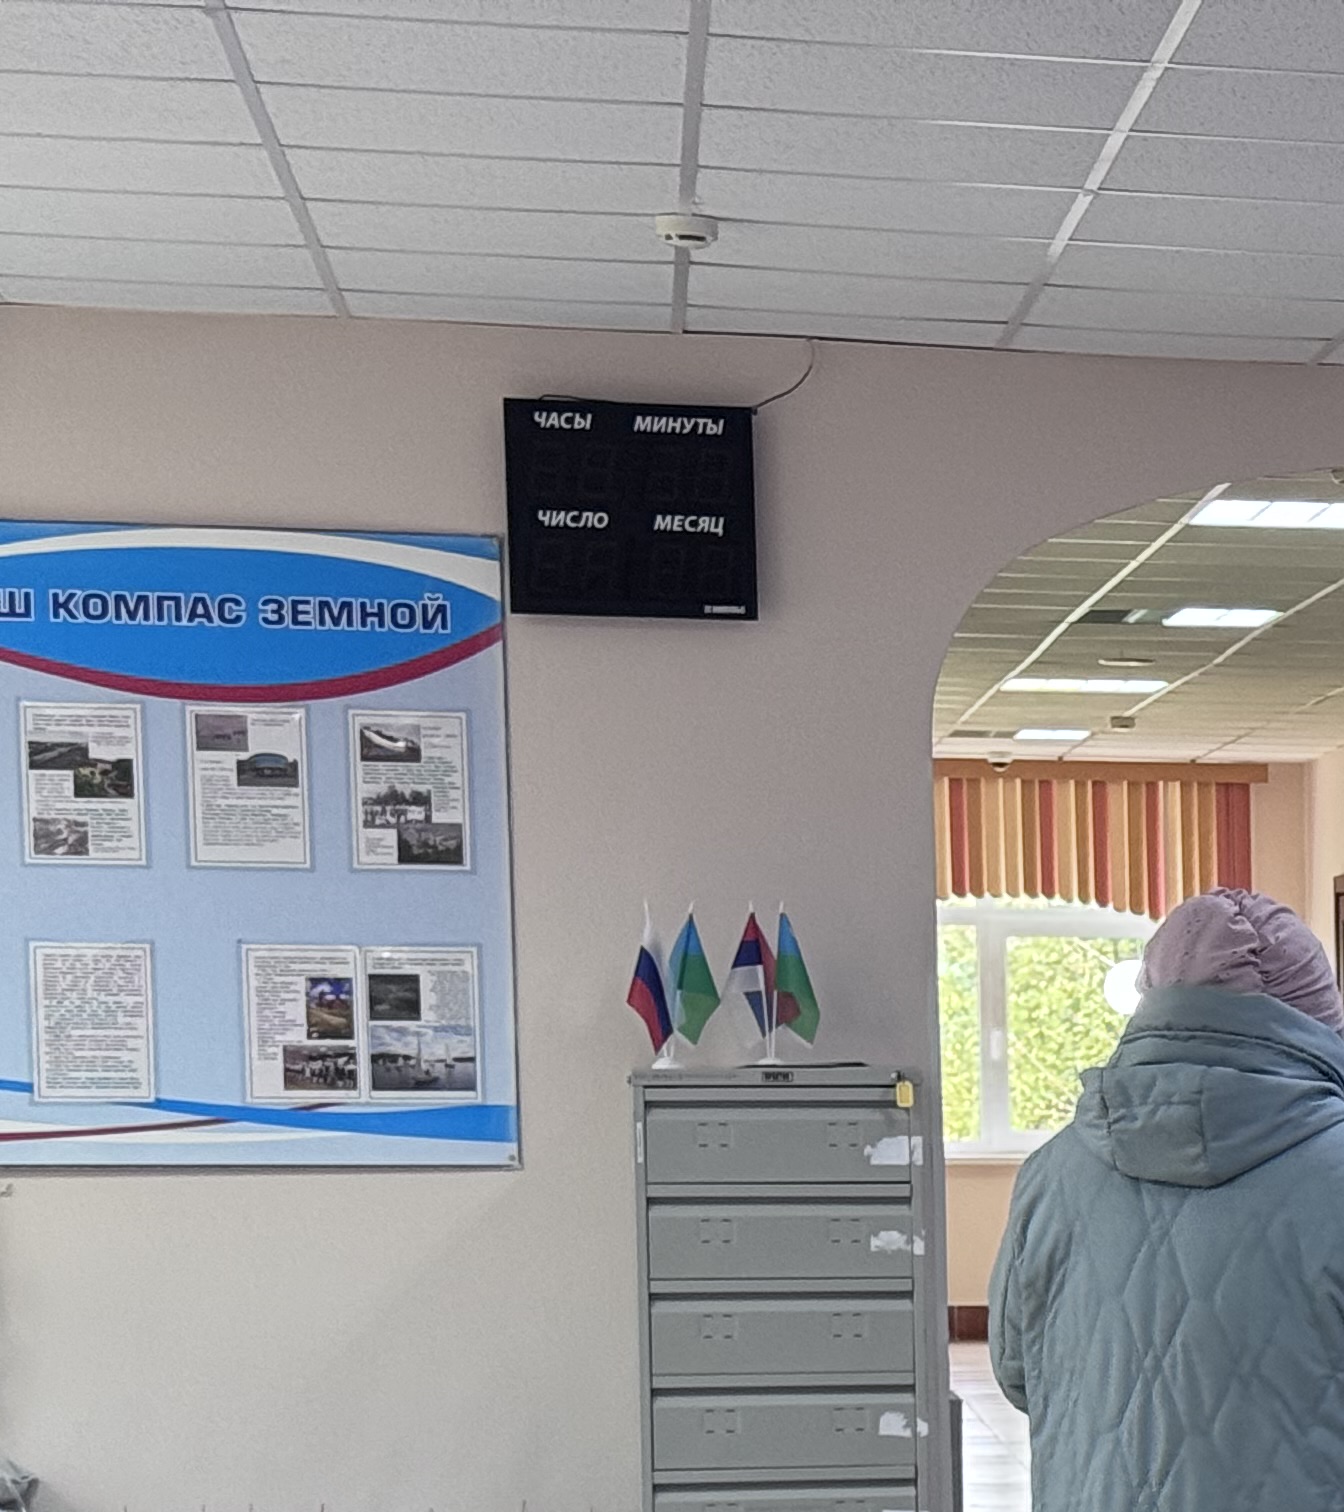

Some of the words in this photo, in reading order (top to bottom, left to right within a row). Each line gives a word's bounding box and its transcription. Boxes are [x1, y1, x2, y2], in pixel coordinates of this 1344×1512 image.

[533, 411, 593, 431] ЧАСЫ
[633, 415, 725, 436] МИНУТЫ
[537, 509, 610, 529] ЧИСЛО
[653, 514, 725, 537] МЕСЯЦ
[49, 589, 246, 627] КОМПАС
[258, 593, 451, 633] ЗЕМНОЙ
